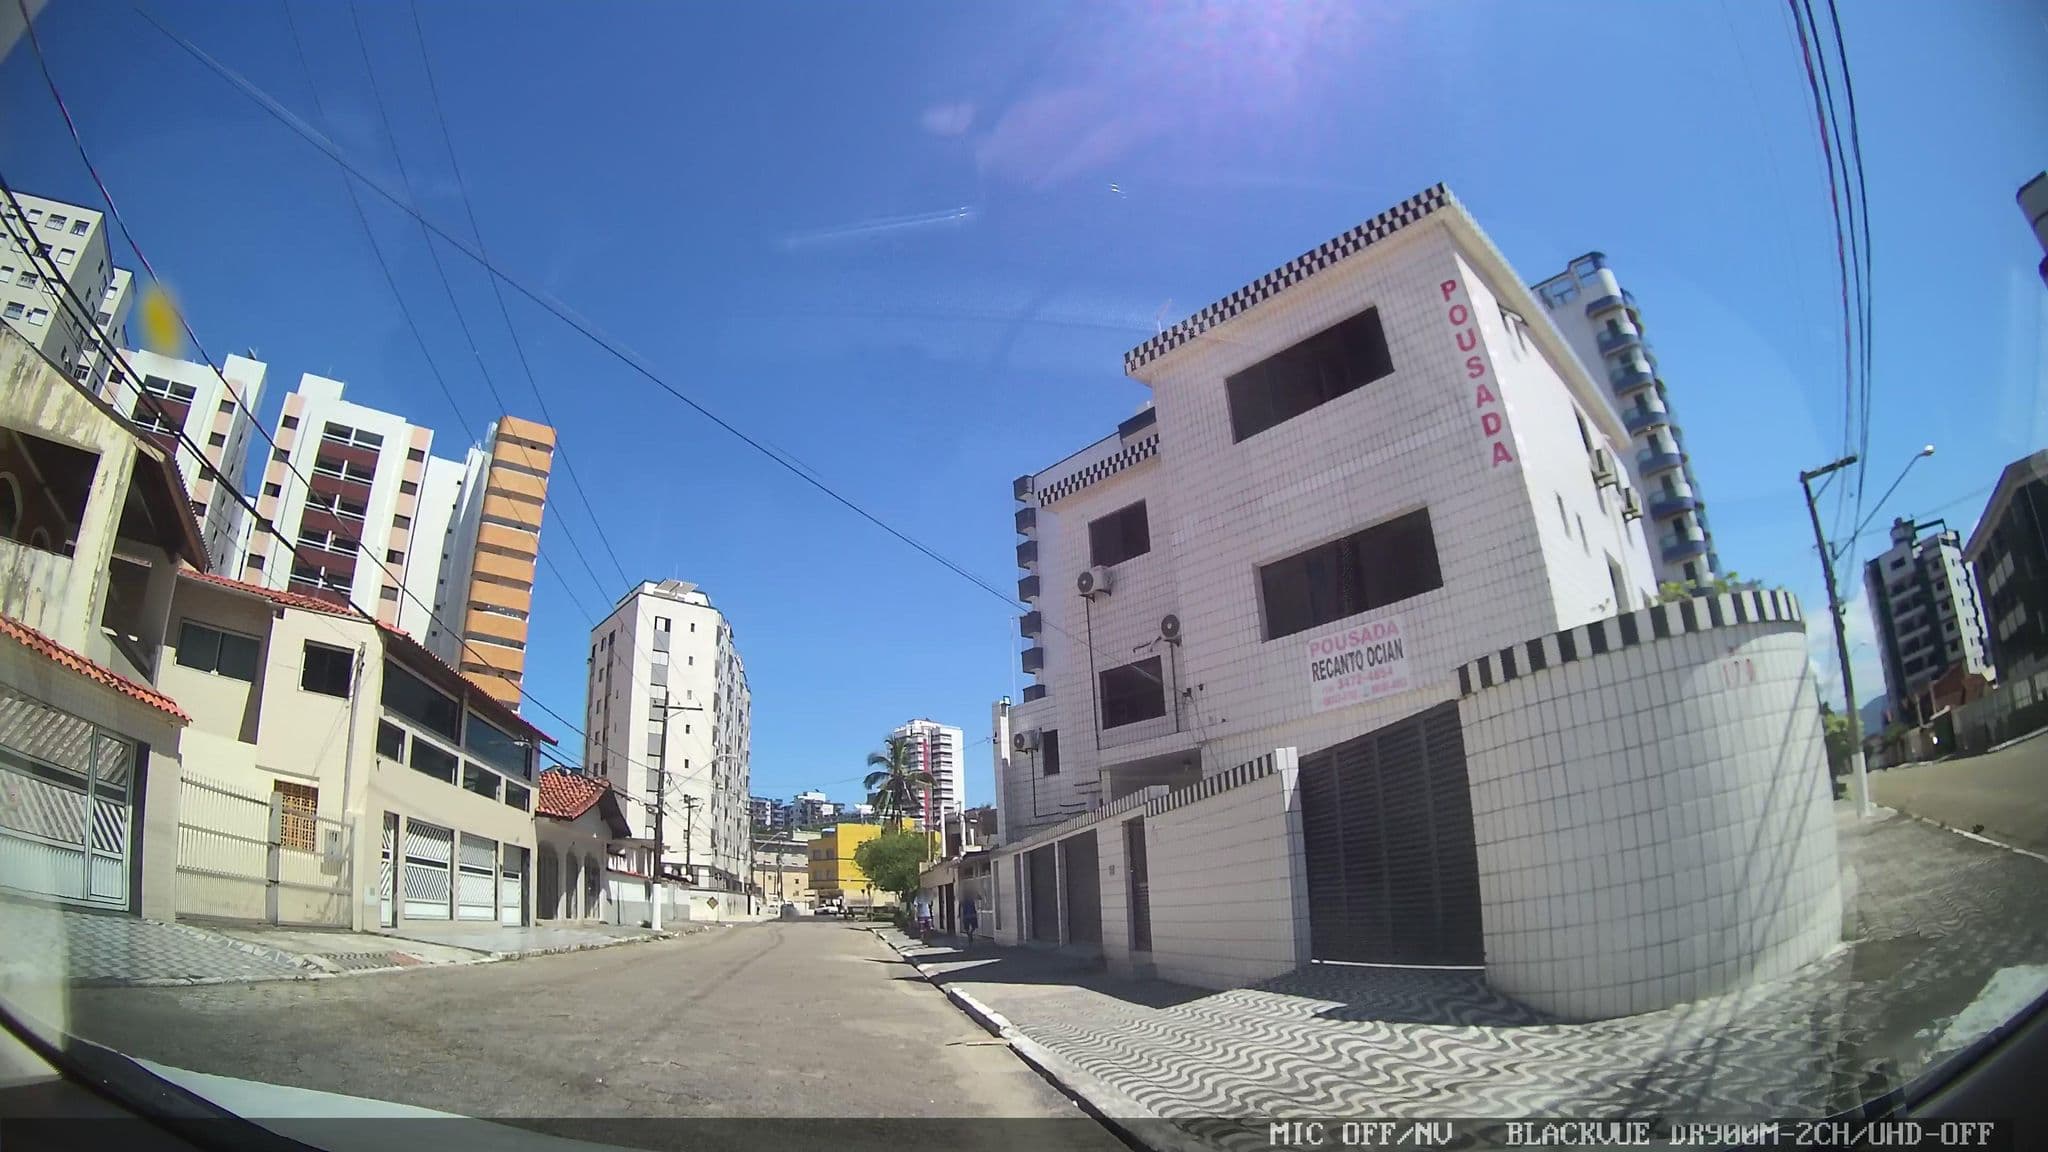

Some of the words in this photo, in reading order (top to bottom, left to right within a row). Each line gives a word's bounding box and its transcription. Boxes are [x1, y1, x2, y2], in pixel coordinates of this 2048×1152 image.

[1440, 279, 1513, 468] POUSADA
[1310, 622, 1399, 657] POUSADA
[1311, 649, 1364, 682] RECANTO
[1366, 638, 1404, 667] OCIAN
